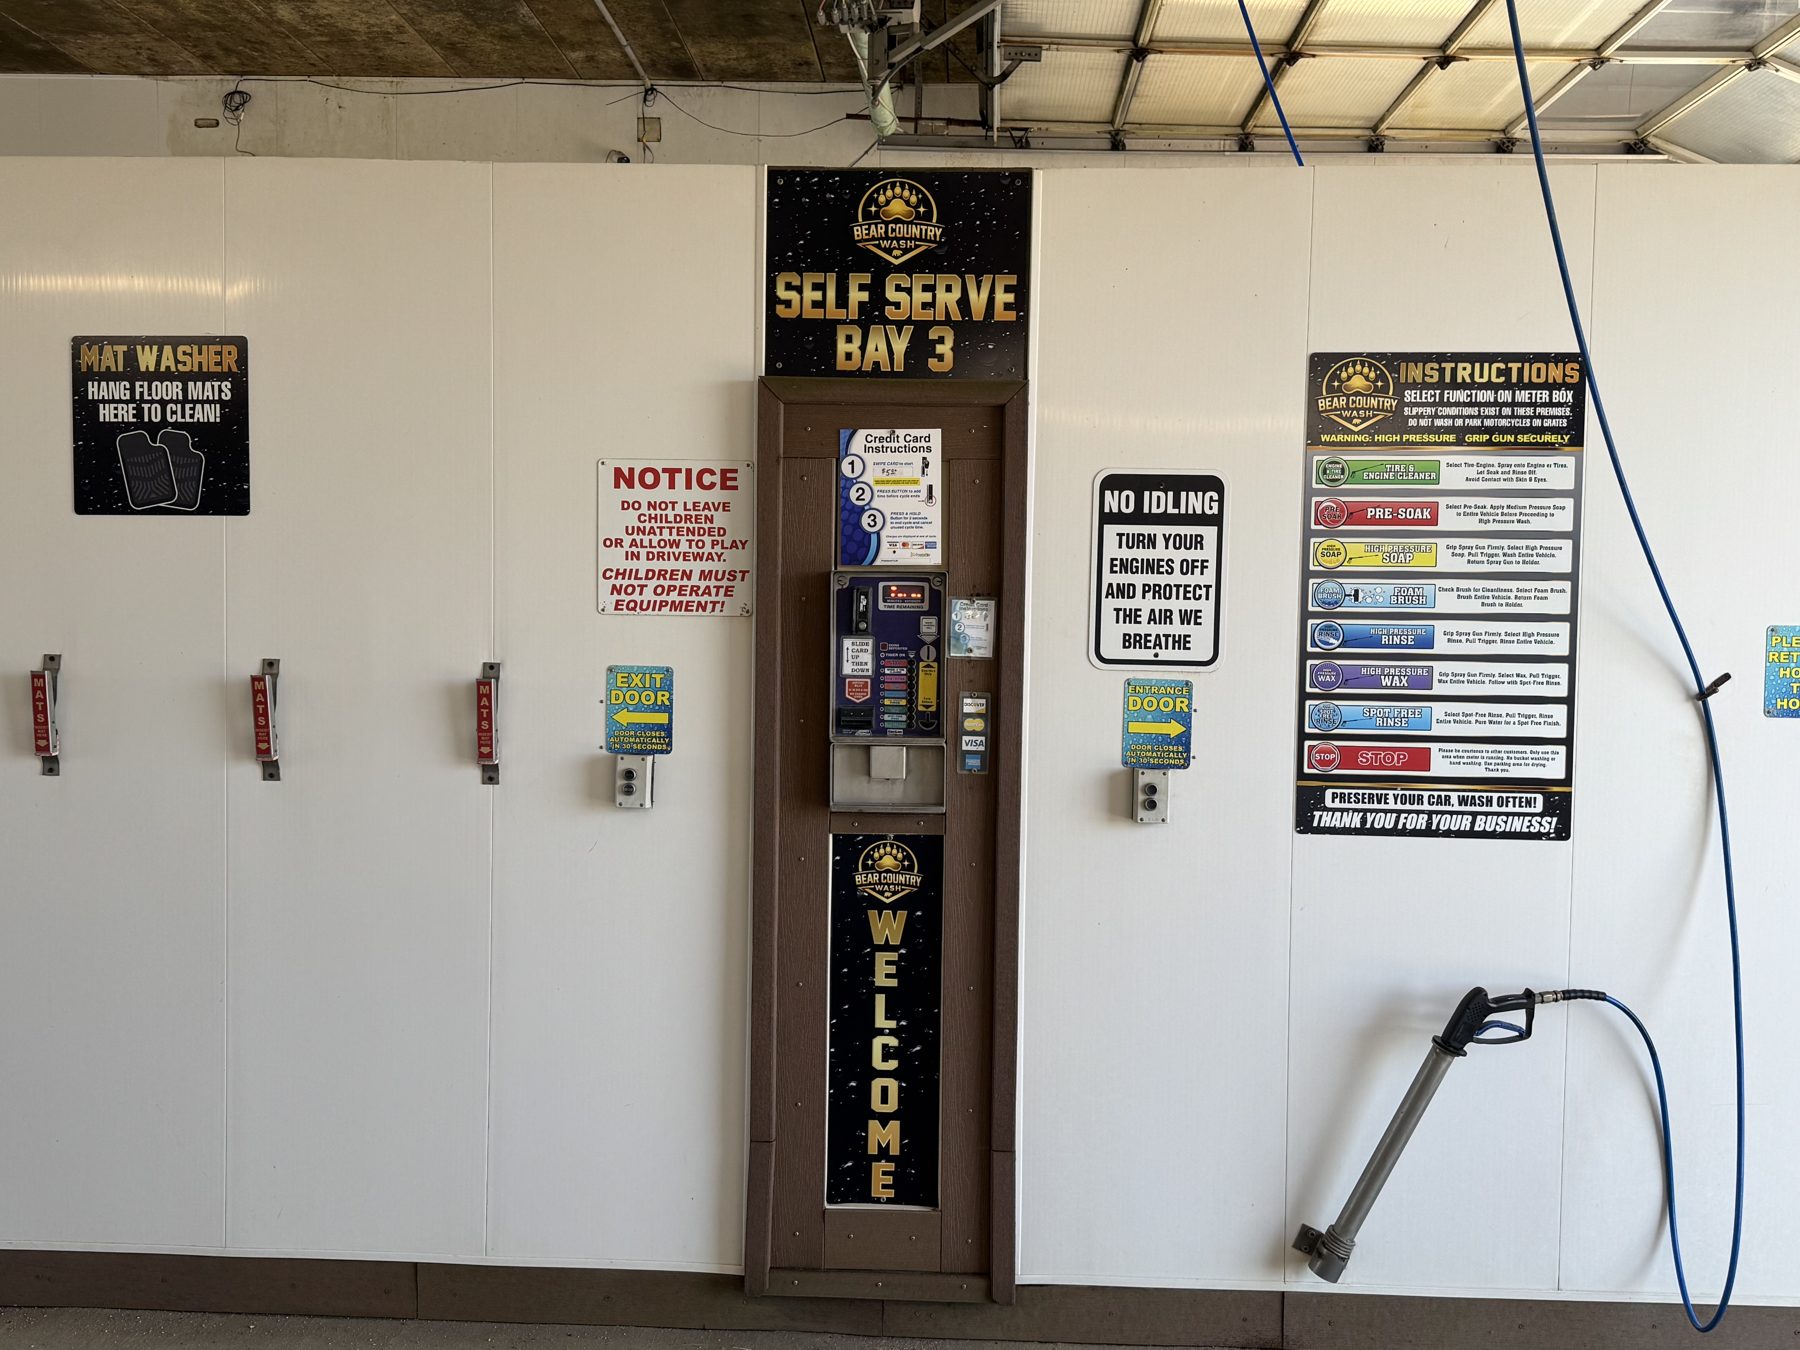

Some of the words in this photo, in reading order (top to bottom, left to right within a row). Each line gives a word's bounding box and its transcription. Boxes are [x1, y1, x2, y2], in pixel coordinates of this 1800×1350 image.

[854, 224, 885, 240] BEAR
[888, 224, 942, 241] COUNTRY
[880, 240, 914, 248] WASH
[776, 272, 871, 320] SELF
[885, 274, 1017, 321] SERVE
[836, 325, 914, 371] BAY
[928, 326, 954, 372] 3
[81, 345, 127, 372] MAT
[136, 345, 238, 372] WASHER
[1400, 362, 1580, 384] INSTRUCTIONS
[88, 381, 130, 400] HANG
[136, 381, 182, 400] FLOOR
[188, 381, 231, 400] MATS
[1404, 390, 1440, 402] SELECT
[1444, 390, 1494, 402] FUNCTION
[1498, 390, 1512, 402] ON
[1515, 390, 1549, 402] METER
[1552, 390, 1573, 402] BOX
[1318, 397, 1346, 410] BEAR
[1349, 396, 1398, 411] COUNTRY
[99, 404, 136, 422] HERE
[142, 404, 161, 422] TO
[167, 404, 220, 422] CLEAN!
[1404, 407, 1435, 415] SLIPPERY
[1438, 407, 1478, 415] CONDITIONS
[1480, 407, 1500, 416] EXIST
[1502, 407, 1511, 415] ON
[1514, 407, 1534, 415] THESE
[1536, 407, 1572, 415] PREMISES.
[865, 434, 900, 443] Credit
[904, 434, 930, 443] Card
[1321, 434, 1372, 442] WARNING:
[1375, 434, 1400, 442] HIGH
[1403, 434, 1456, 442] PRESSURE
[1465, 434, 1489, 442] GRIP
[1492, 434, 1514, 442] GUN
[1517, 434, 1570, 442] SECURELY
[864, 444, 932, 453] Instructions
[848, 460, 854, 474] 1
[1385, 464, 1406, 472] TIRE
[1408, 464, 1414, 472] &
[614, 467, 738, 490] NOTICE
[1364, 472, 1396, 480] ENGINE
[856, 487, 865, 501] 2
[621, 500, 641, 510] DO
[647, 501, 678, 511] NOT
[683, 502, 731, 512] LEAVE
[1104, 490, 1135, 513] NO
[1143, 491, 1218, 514] IDLING
[638, 514, 714, 524] CHILDREN
[868, 514, 877, 527] 3
[1367, 508, 1431, 519] PRE-SOAK
[625, 526, 726, 537] UNATTENDED
[603, 538, 624, 548] OR
[629, 539, 680, 549] ALLOW
[686, 539, 705, 549] TO
[711, 540, 748, 550] PLAY
[1116, 533, 1156, 549] TURN
[1163, 534, 1204, 550] YOUR
[1364, 545, 1384, 553] HIGH
[1388, 545, 1432, 553] PRESSURE
[625, 551, 640, 560] IN
[646, 551, 726, 562] DRIVEWAY.
[1382, 553, 1414, 564] SOAP
[1110, 558, 1174, 575] ENGINES
[1180, 559, 1209, 575] OFF
[602, 568, 693, 581] CHILDREN
[699, 570, 750, 582] MUST
[610, 584, 648, 596] NOT
[653, 585, 735, 597] OPERATE
[1105, 583, 1136, 599] AND
[1142, 584, 1212, 600] PROTECT
[1394, 587, 1424, 596] FOAM
[614, 599, 725, 612] EQUIPMENT!
[1390, 596, 1427, 604] BRUSH
[1113, 608, 1142, 624] THE
[1147, 609, 1173, 625] AIR
[1179, 609, 1202, 625] WE
[1122, 634, 1191, 650] BREATHE
[1382, 636, 1415, 645] RINSE
[616, 673, 664, 688] EXIT
[1381, 676, 1408, 687] WAX
[1128, 686, 1189, 694] ENTRANCE
[34, 678, 45, 722] MATS
[254, 682, 266, 725] MATS
[610, 690, 670, 705] DOOR
[1128, 696, 1189, 712] DOOR
[480, 686, 489, 729] MATS
[1363, 708, 1390, 718] SPOT
[1395, 709, 1422, 718] FREE
[1376, 718, 1409, 727] RINSE
[1358, 751, 1408, 766] STOP
[1332, 792, 1389, 804] PRESERVE
[1393, 793, 1424, 805] YOUR
[1428, 794, 1454, 807] CAR,
[1457, 795, 1493, 807] WASH
[1497, 796, 1537, 808] OFTEN!
[1313, 811, 1363, 828] THANK
[1365, 812, 1398, 829] YOU
[1397, 813, 1428, 829] FOR
[1431, 814, 1472, 831] YOUR
[1474, 816, 1558, 833] BUSINESS!
[855, 873, 879, 885] BEAR
[881, 873, 922, 886] COUNTRY
[867, 910, 908, 1197] WELCOME
